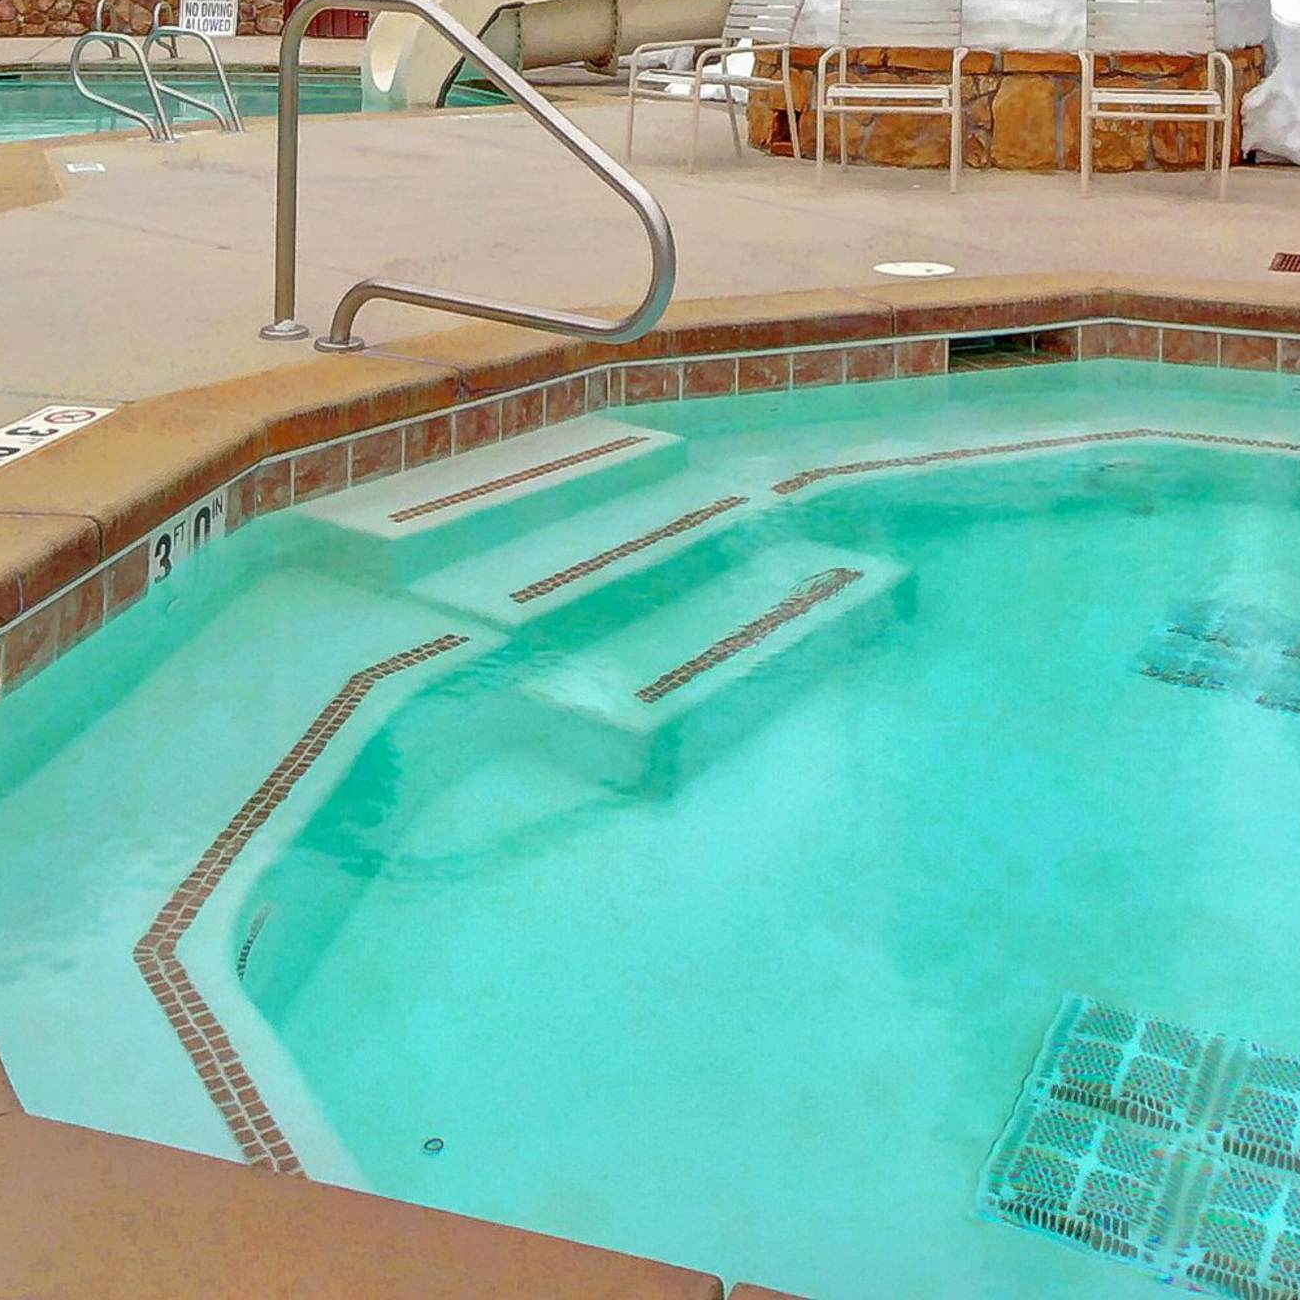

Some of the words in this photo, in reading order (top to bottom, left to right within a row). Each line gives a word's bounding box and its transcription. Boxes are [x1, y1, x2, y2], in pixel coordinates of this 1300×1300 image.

[186, 3, 199, 17] NO
[201, 3, 233, 17] DIVING
[186, 19, 231, 32] ALLOWED
[154, 533, 172, 584] 3
[174, 520, 186, 546] FT
[212, 494, 223, 520] IN
